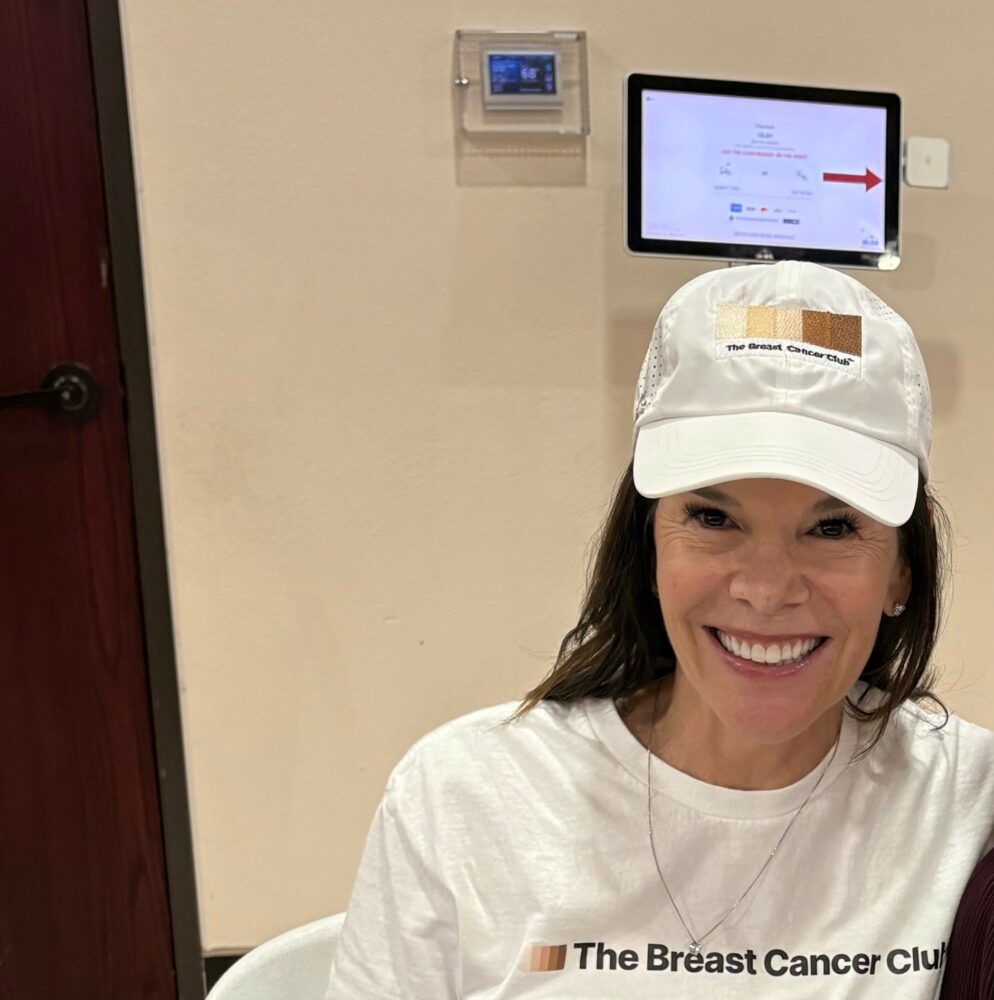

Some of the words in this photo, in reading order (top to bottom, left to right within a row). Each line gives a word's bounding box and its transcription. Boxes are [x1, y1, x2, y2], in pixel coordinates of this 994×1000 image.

[726, 344, 745, 352] The
[748, 343, 783, 351] Breast
[787, 345, 824, 359] Cancer
[573, 942, 639, 971] The
[647, 943, 757, 975] Breast
[764, 948, 881, 977] Cancer
